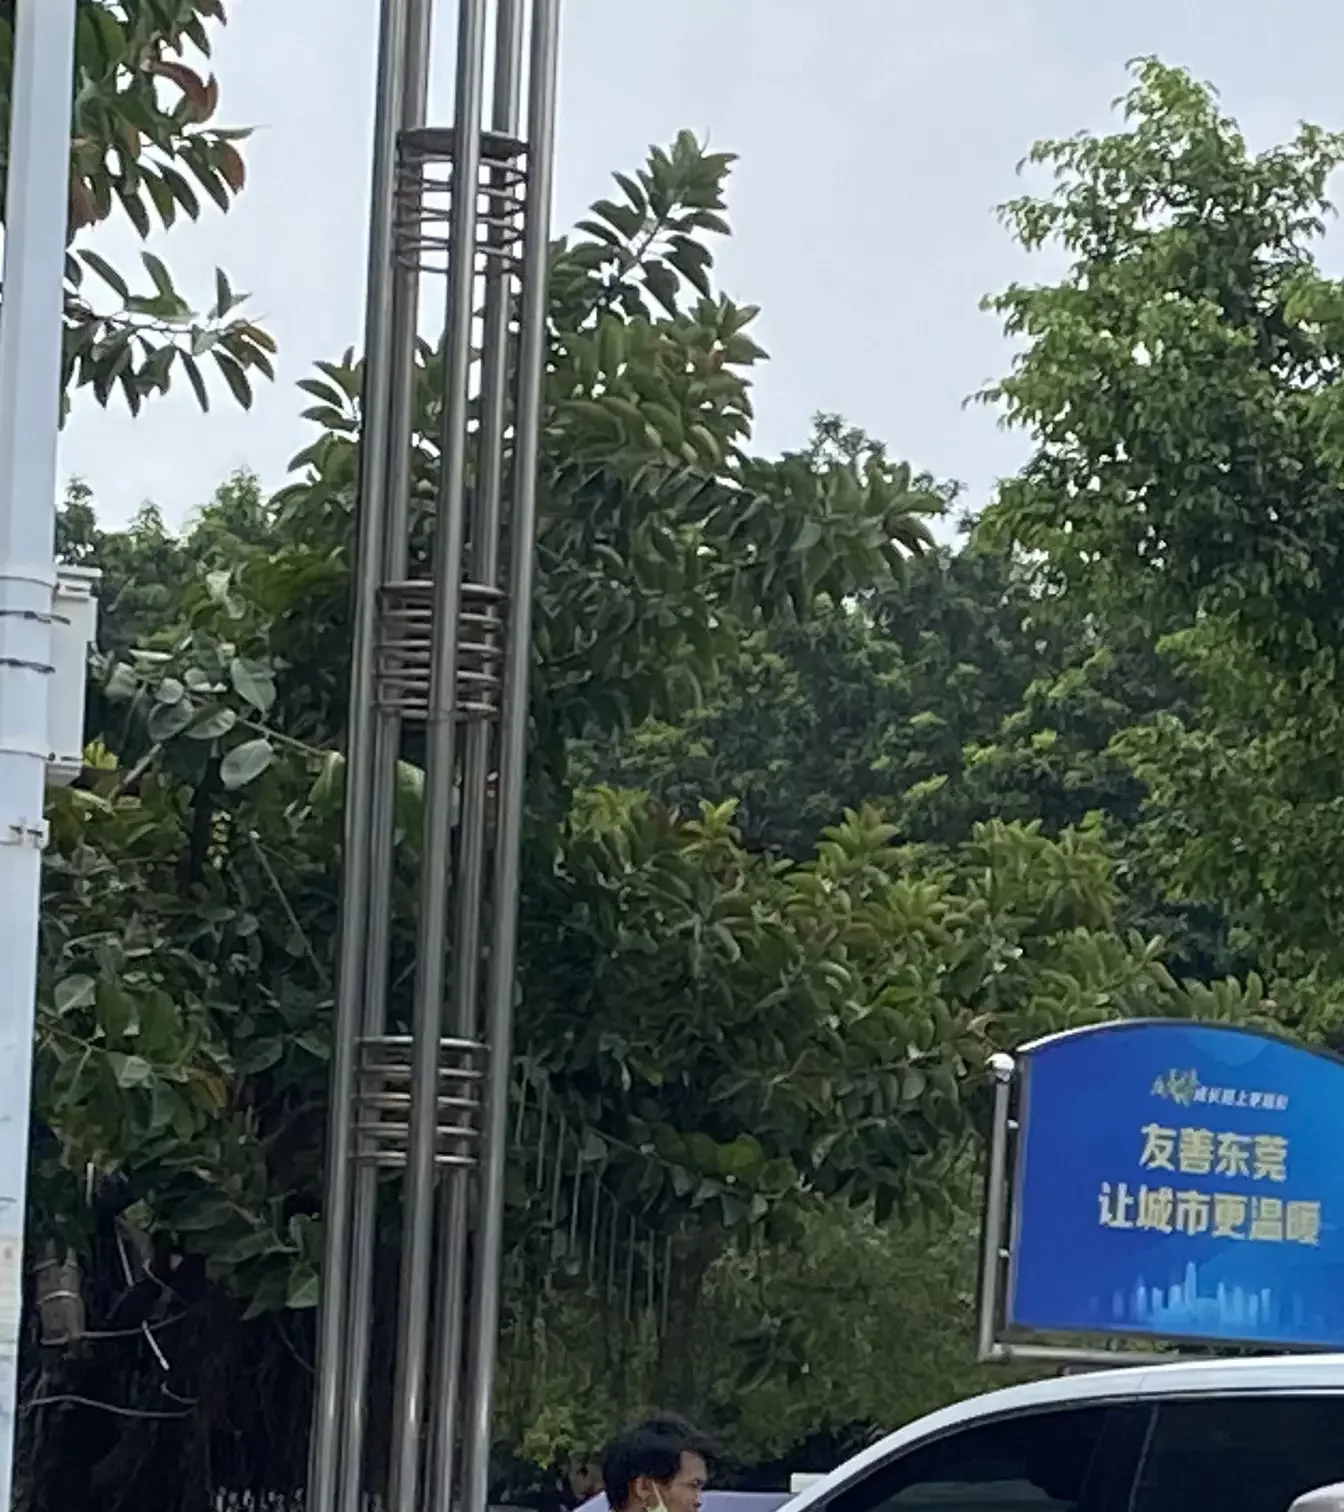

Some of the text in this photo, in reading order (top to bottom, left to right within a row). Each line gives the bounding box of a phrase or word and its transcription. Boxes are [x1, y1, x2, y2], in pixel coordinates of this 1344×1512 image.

[1140, 1123, 1287, 1181] 友善东莞
[1099, 1182, 1320, 1246] 让城市更温暖
